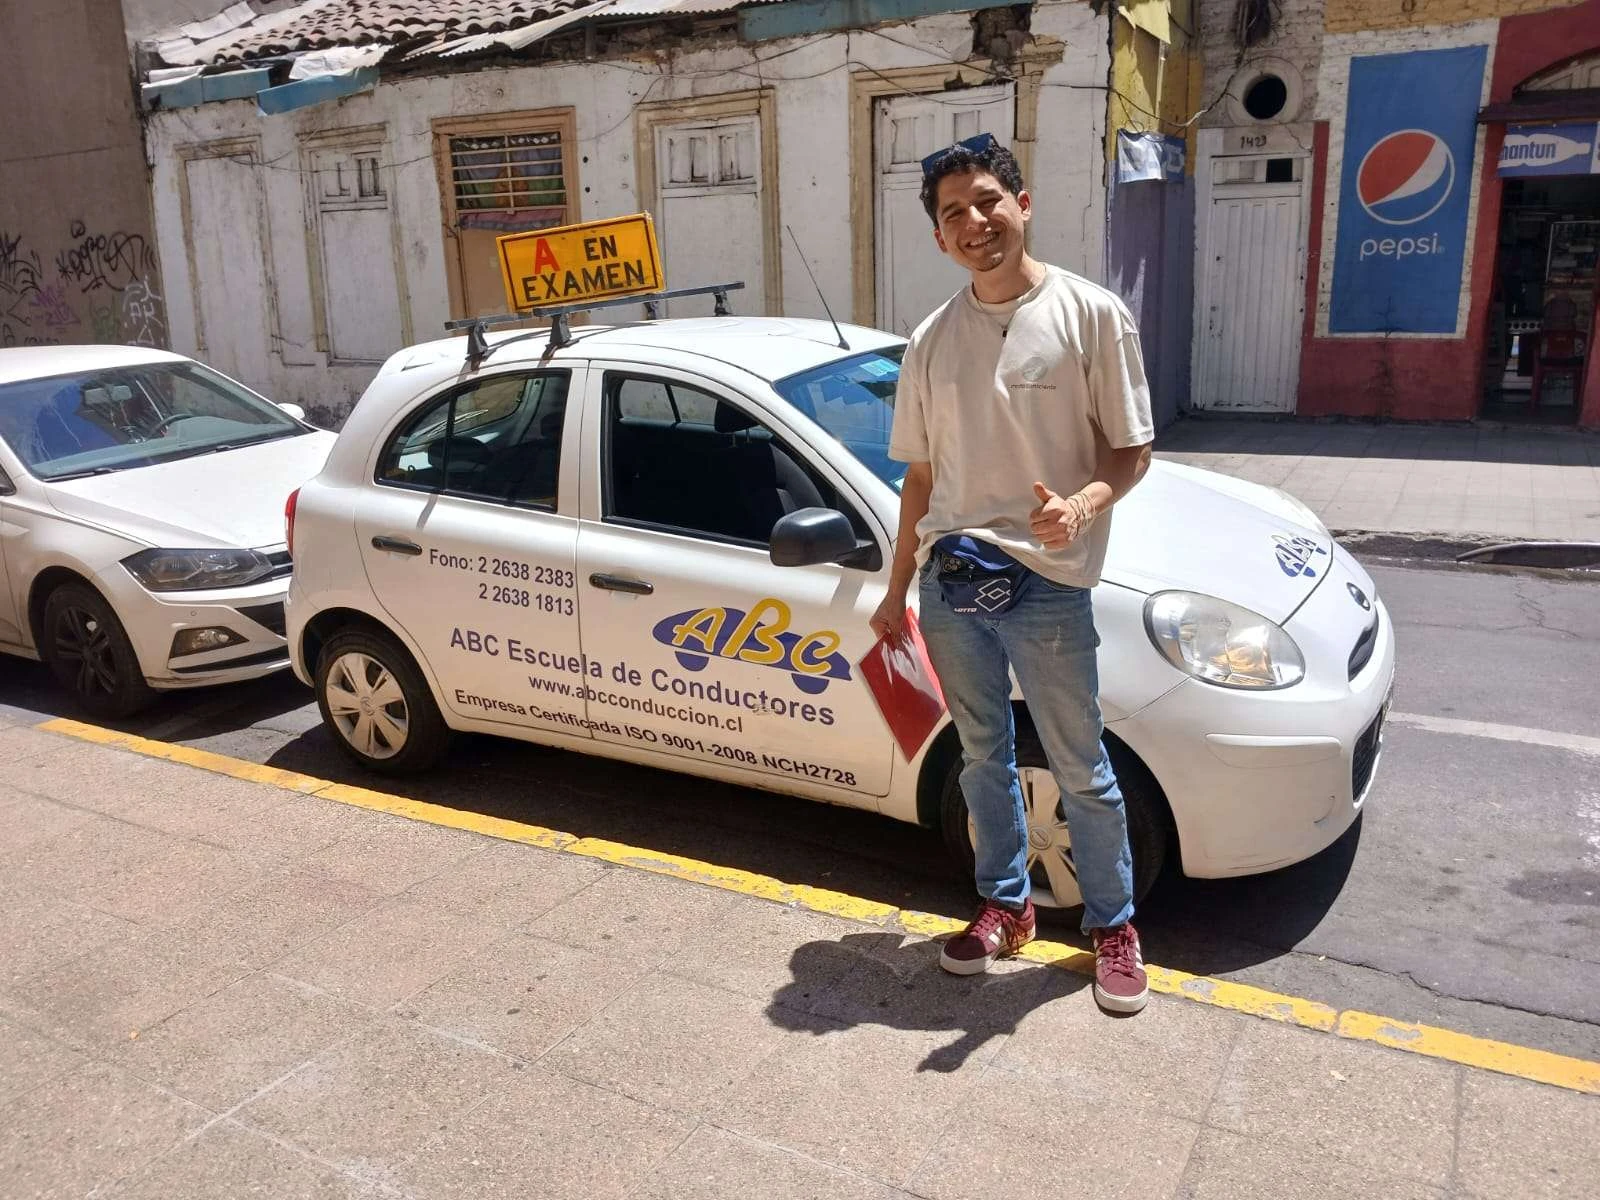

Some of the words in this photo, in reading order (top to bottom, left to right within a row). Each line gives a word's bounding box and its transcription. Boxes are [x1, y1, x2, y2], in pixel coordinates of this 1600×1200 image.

[534, 237, 561, 275] A
[583, 235, 618, 262] EN
[1360, 232, 1438, 261] pepsi
[521, 259, 646, 302] EXAMEN
[429, 549, 473, 571] Fono:
[478, 556, 487, 573] 2
[492, 558, 530, 581] 2638
[534, 566, 574, 589] 2383
[478, 583, 488, 600] 2
[492, 585, 530, 608] 2638
[535, 593, 574, 616] 1813
[450, 627, 500, 657] ABC
[507, 638, 603, 679] Escuela
[612, 661, 642, 687] de
[651, 668, 835, 726] Conductores
[528, 675, 743, 733] www.abcconduccion.cl
[455, 689, 526, 716] Empresa
[529, 705, 621, 735] Certificada
[624, 725, 658, 743] ISO
[661, 732, 758, 765] 9001-2008
[762, 754, 857, 786] NCH2728
